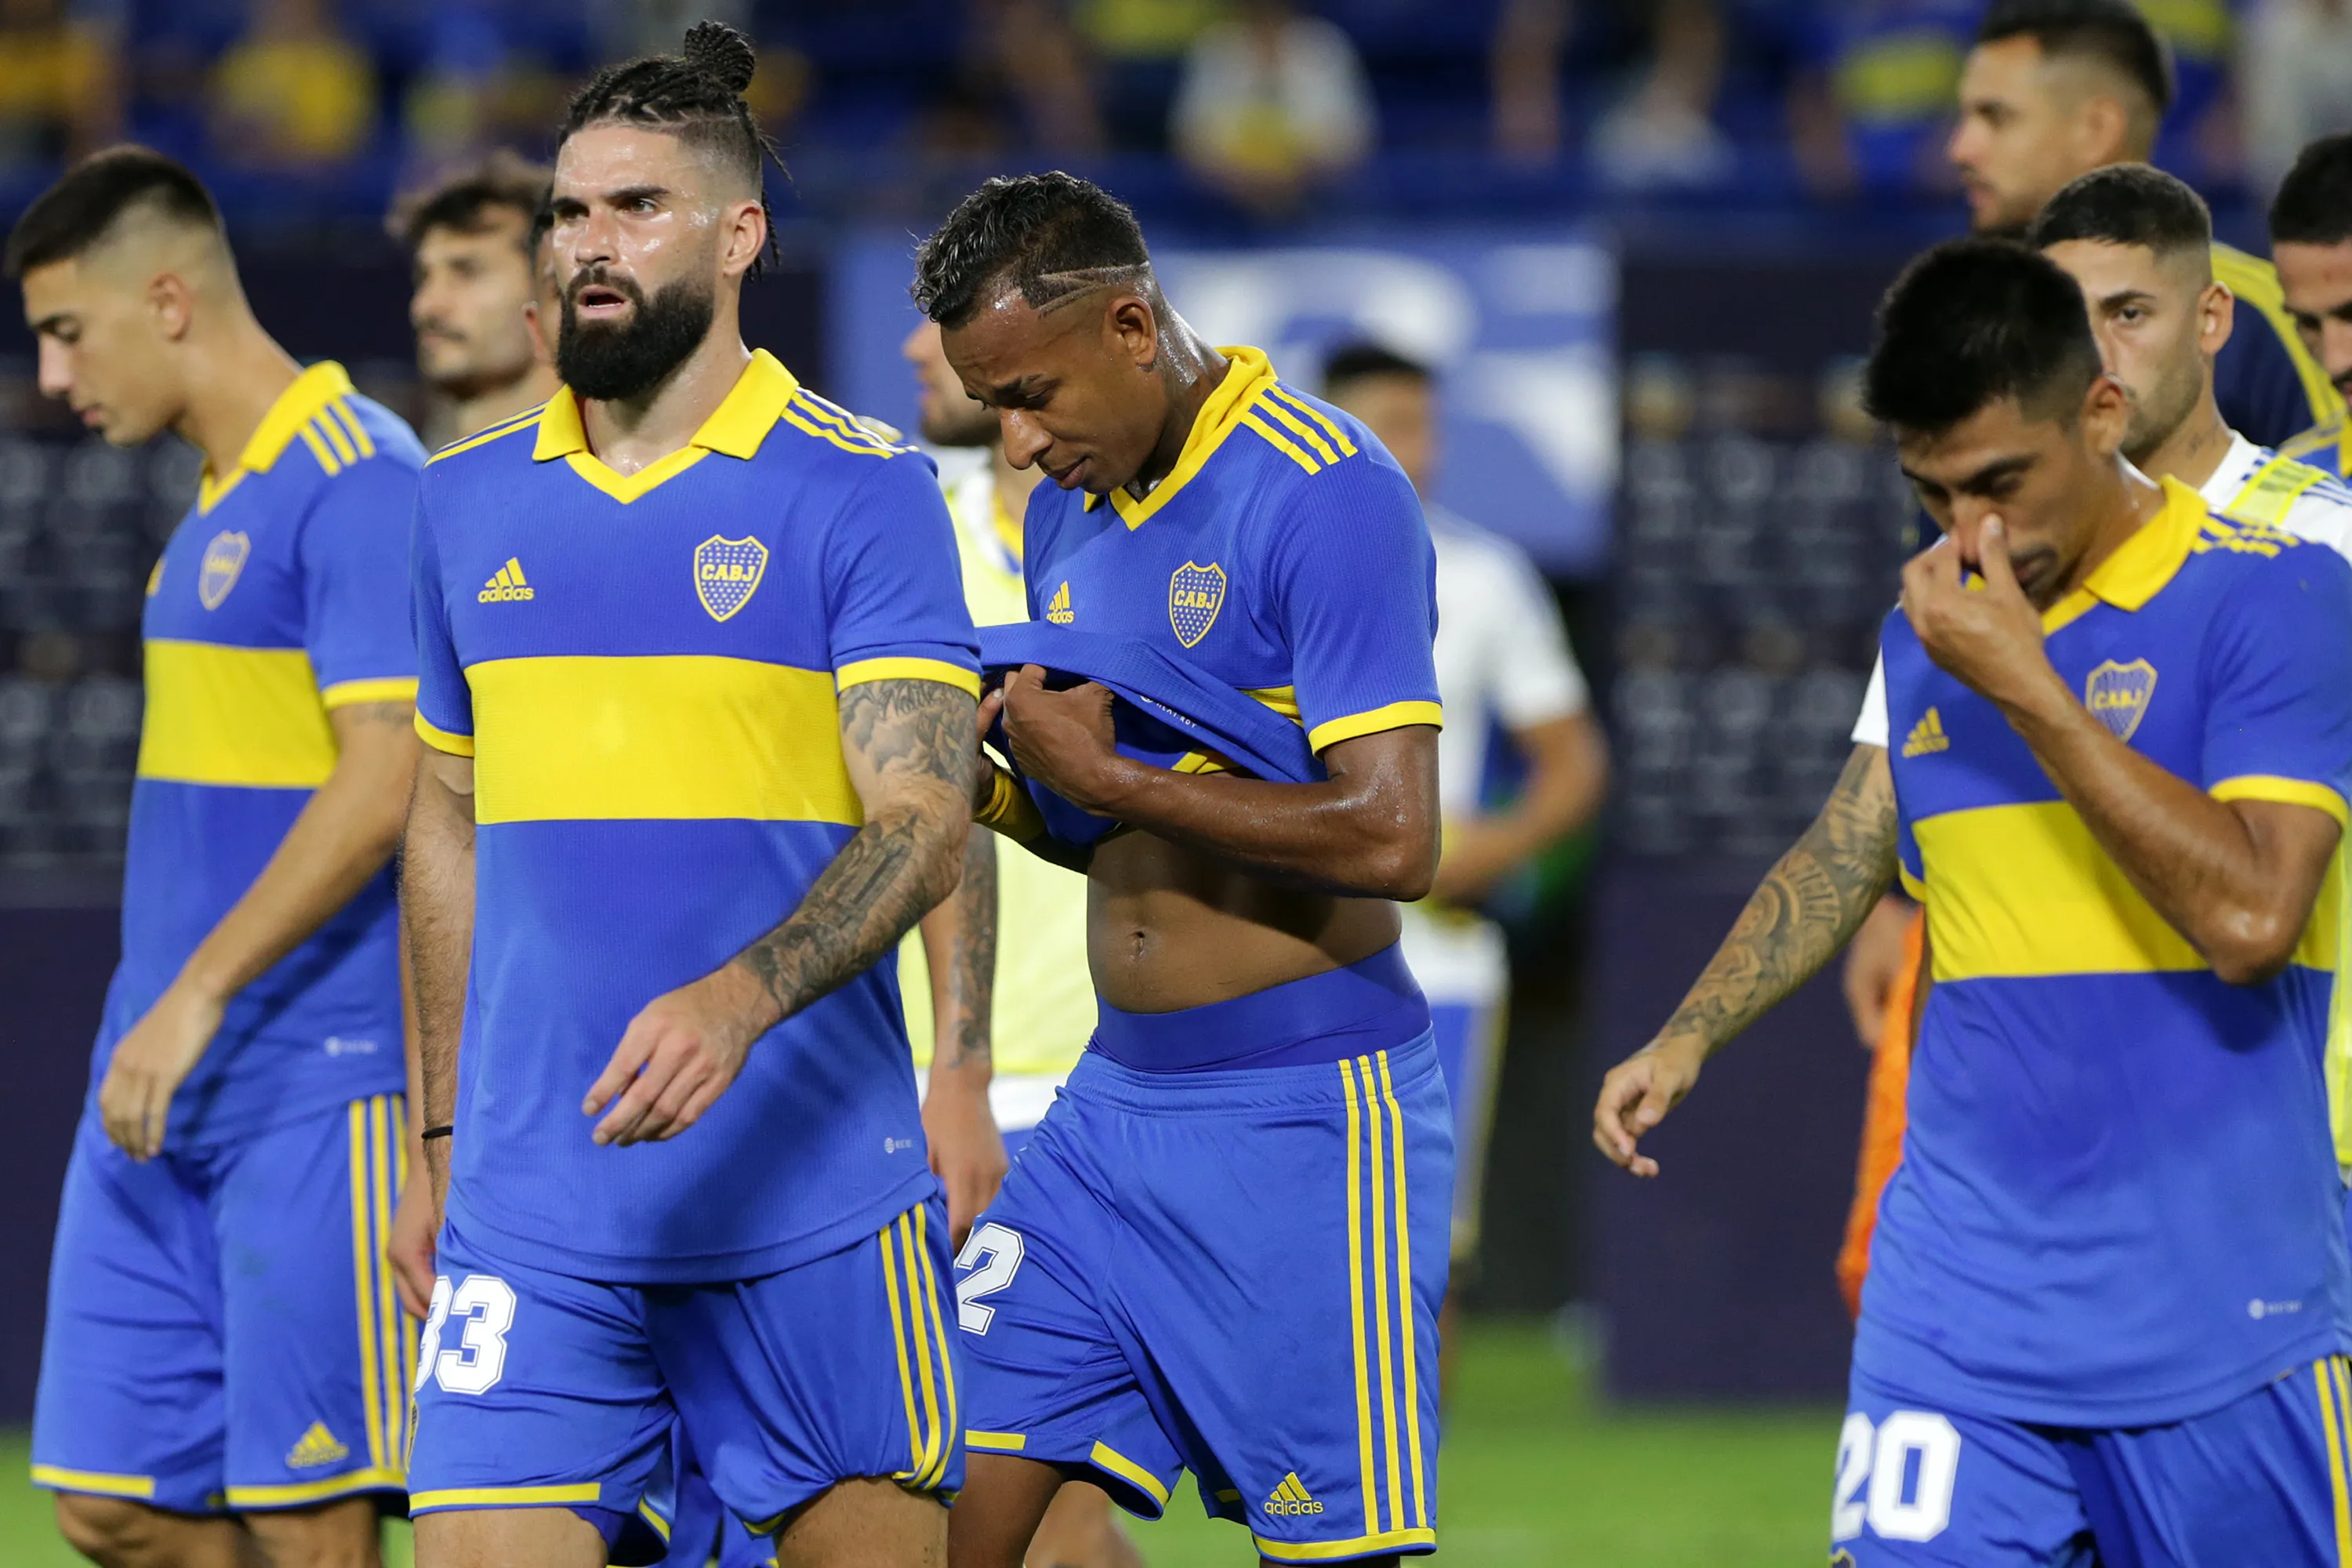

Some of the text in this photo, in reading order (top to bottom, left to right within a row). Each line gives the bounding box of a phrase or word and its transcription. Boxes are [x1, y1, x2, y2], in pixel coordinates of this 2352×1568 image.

[701, 564, 756, 582] CABJ
[477, 586, 535, 603] adidas
[1174, 590, 1217, 609] CABJ
[1831, 1410, 1962, 1543] 20
[1264, 1499, 1324, 1515] adidas
